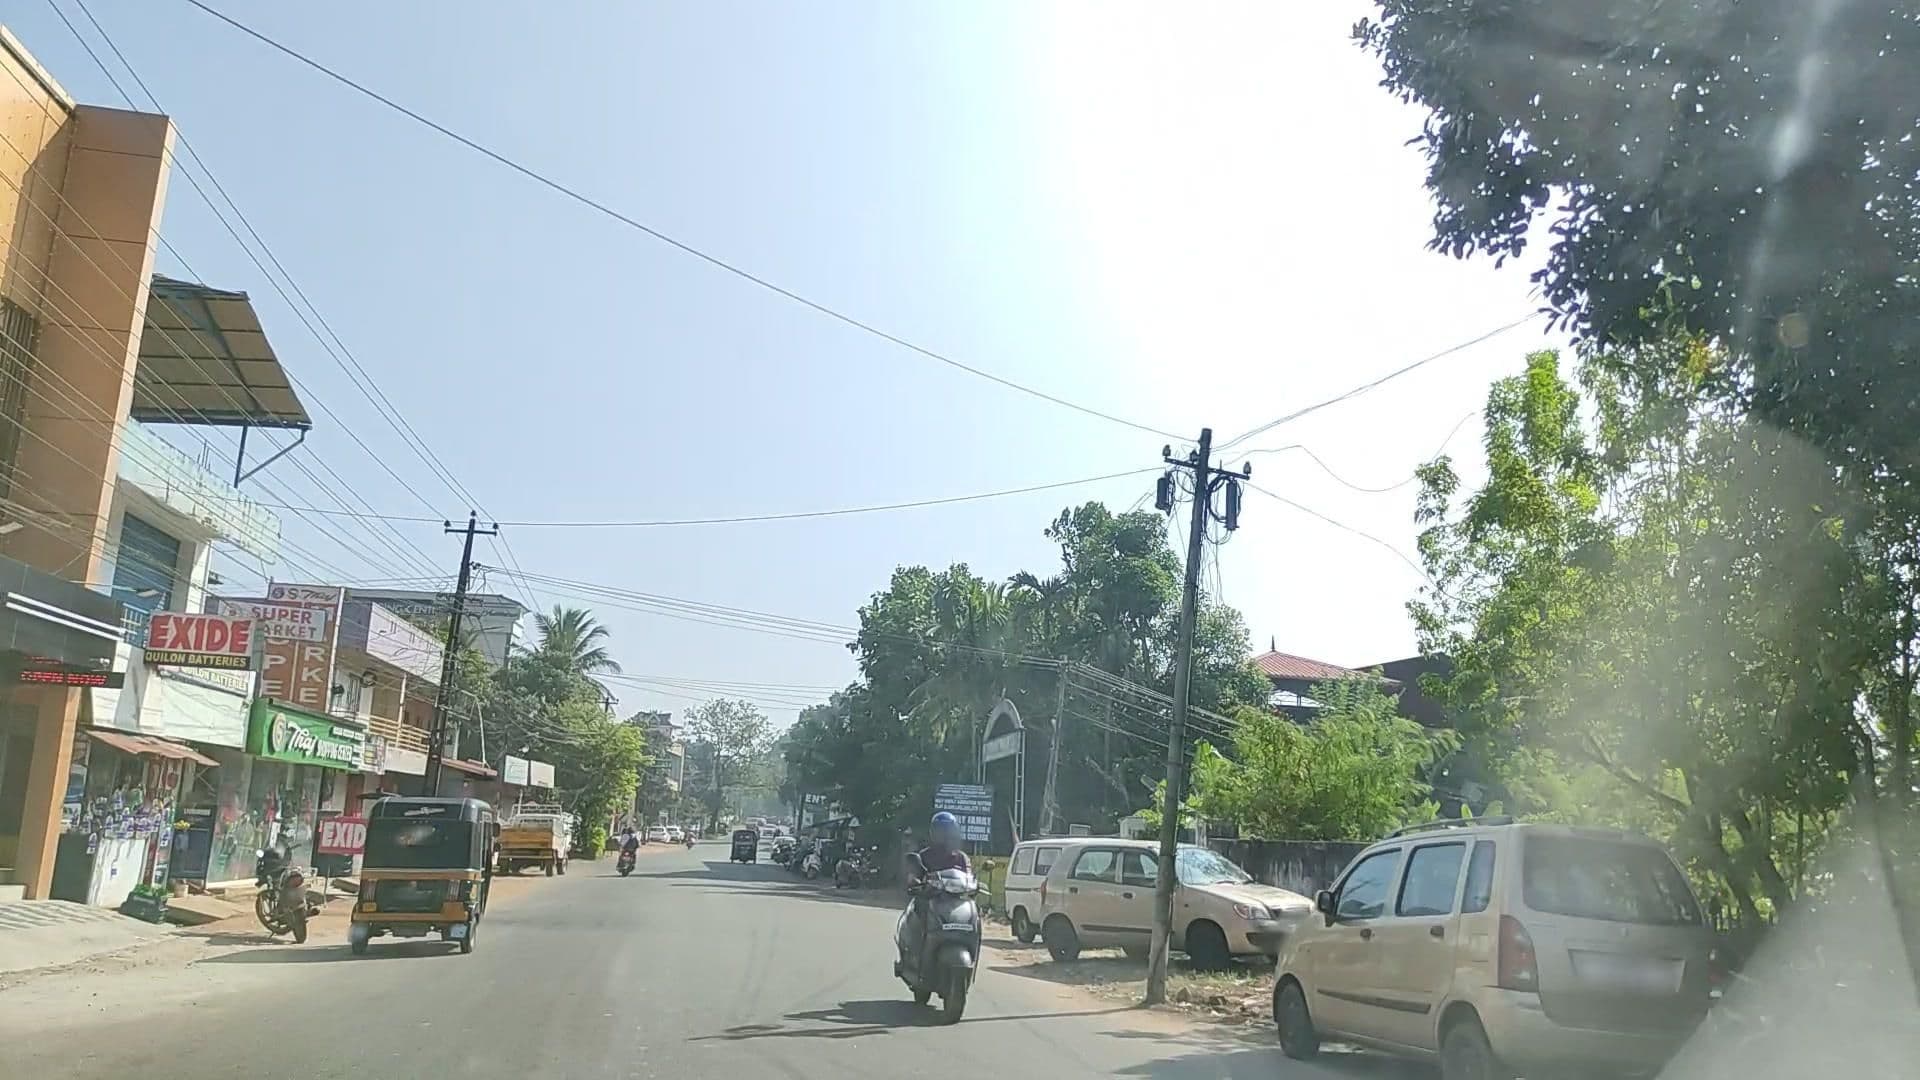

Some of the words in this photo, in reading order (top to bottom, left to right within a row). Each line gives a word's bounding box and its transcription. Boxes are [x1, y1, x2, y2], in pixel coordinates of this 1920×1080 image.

[252, 606, 312, 624] SUPER
[149, 614, 252, 653] EXIDE
[262, 622, 317, 638] ARKET
[145, 651, 185, 663] QUILON
[188, 654, 247, 668] BATTERIES
[322, 821, 367, 849] EXID
